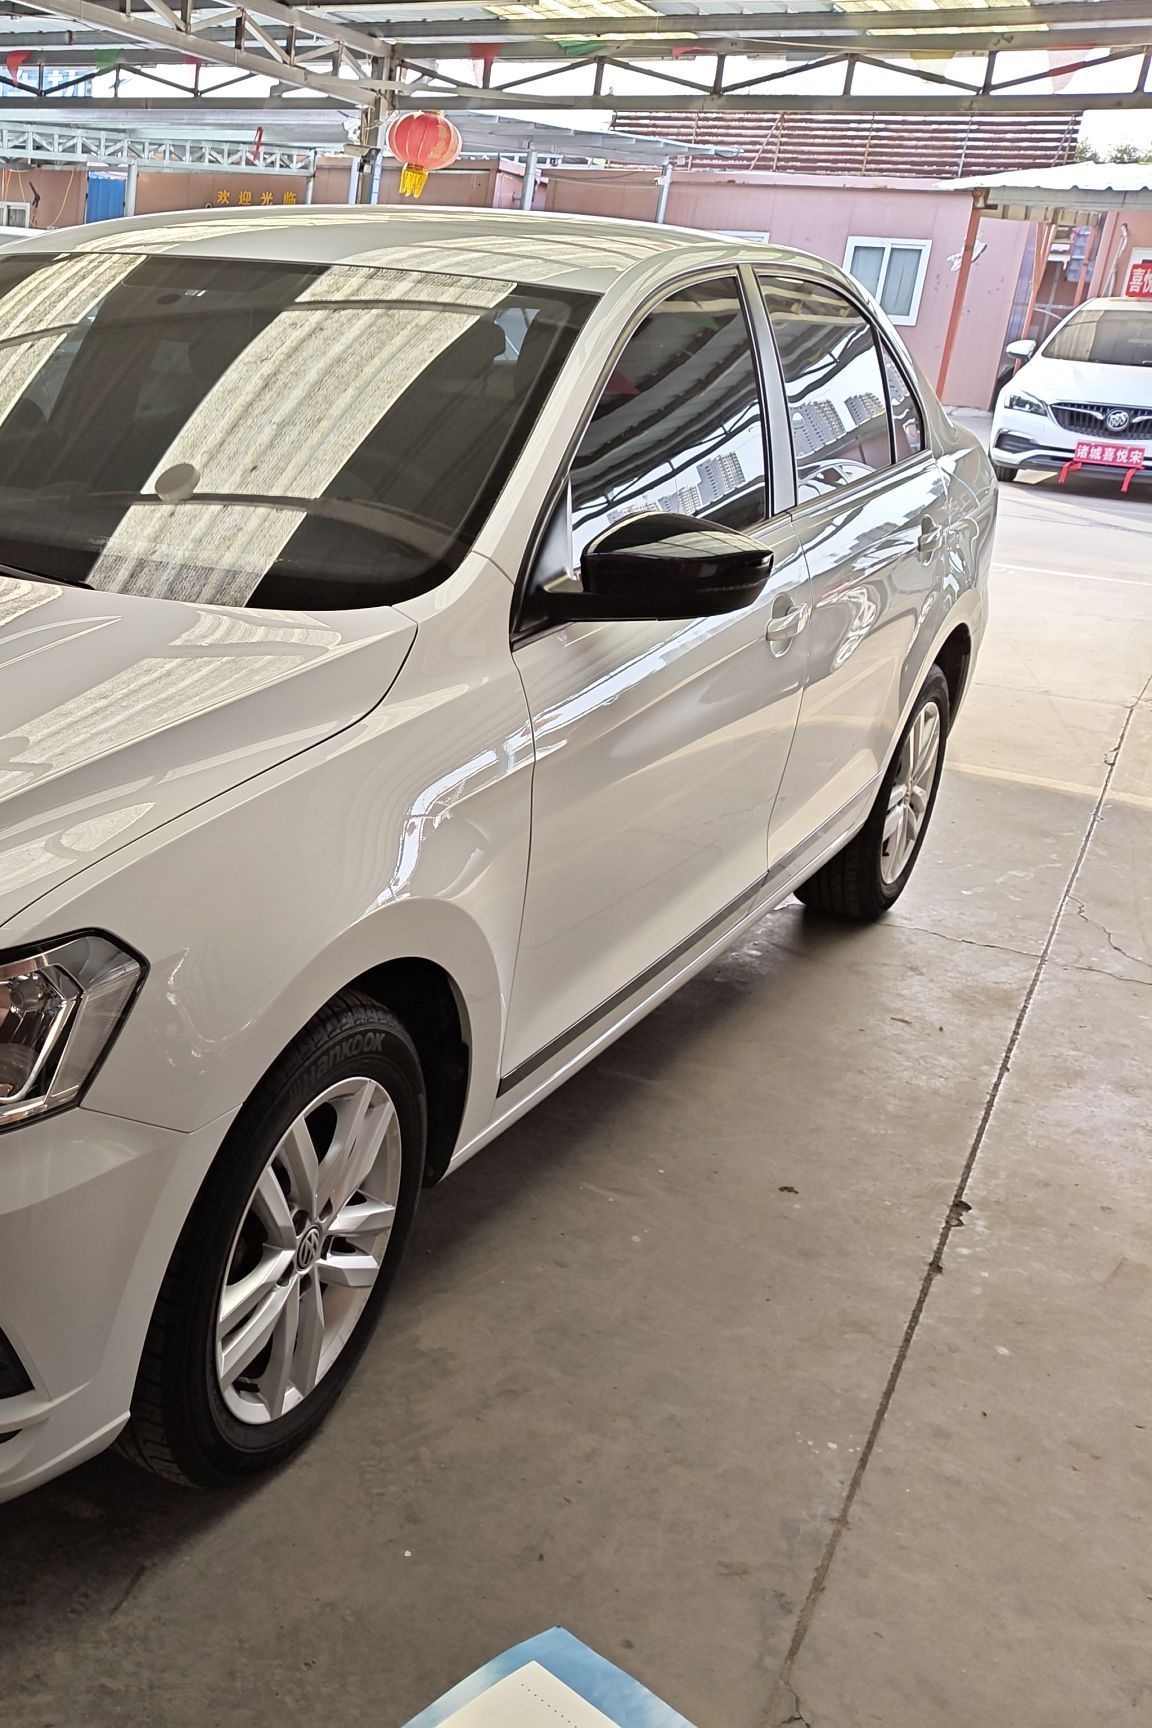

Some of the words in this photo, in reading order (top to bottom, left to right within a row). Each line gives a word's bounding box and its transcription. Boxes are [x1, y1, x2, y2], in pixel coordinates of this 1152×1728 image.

[217, 189, 297, 206] 欢迎光临
[1077, 444, 1143, 465] 诸城喜悦宋
